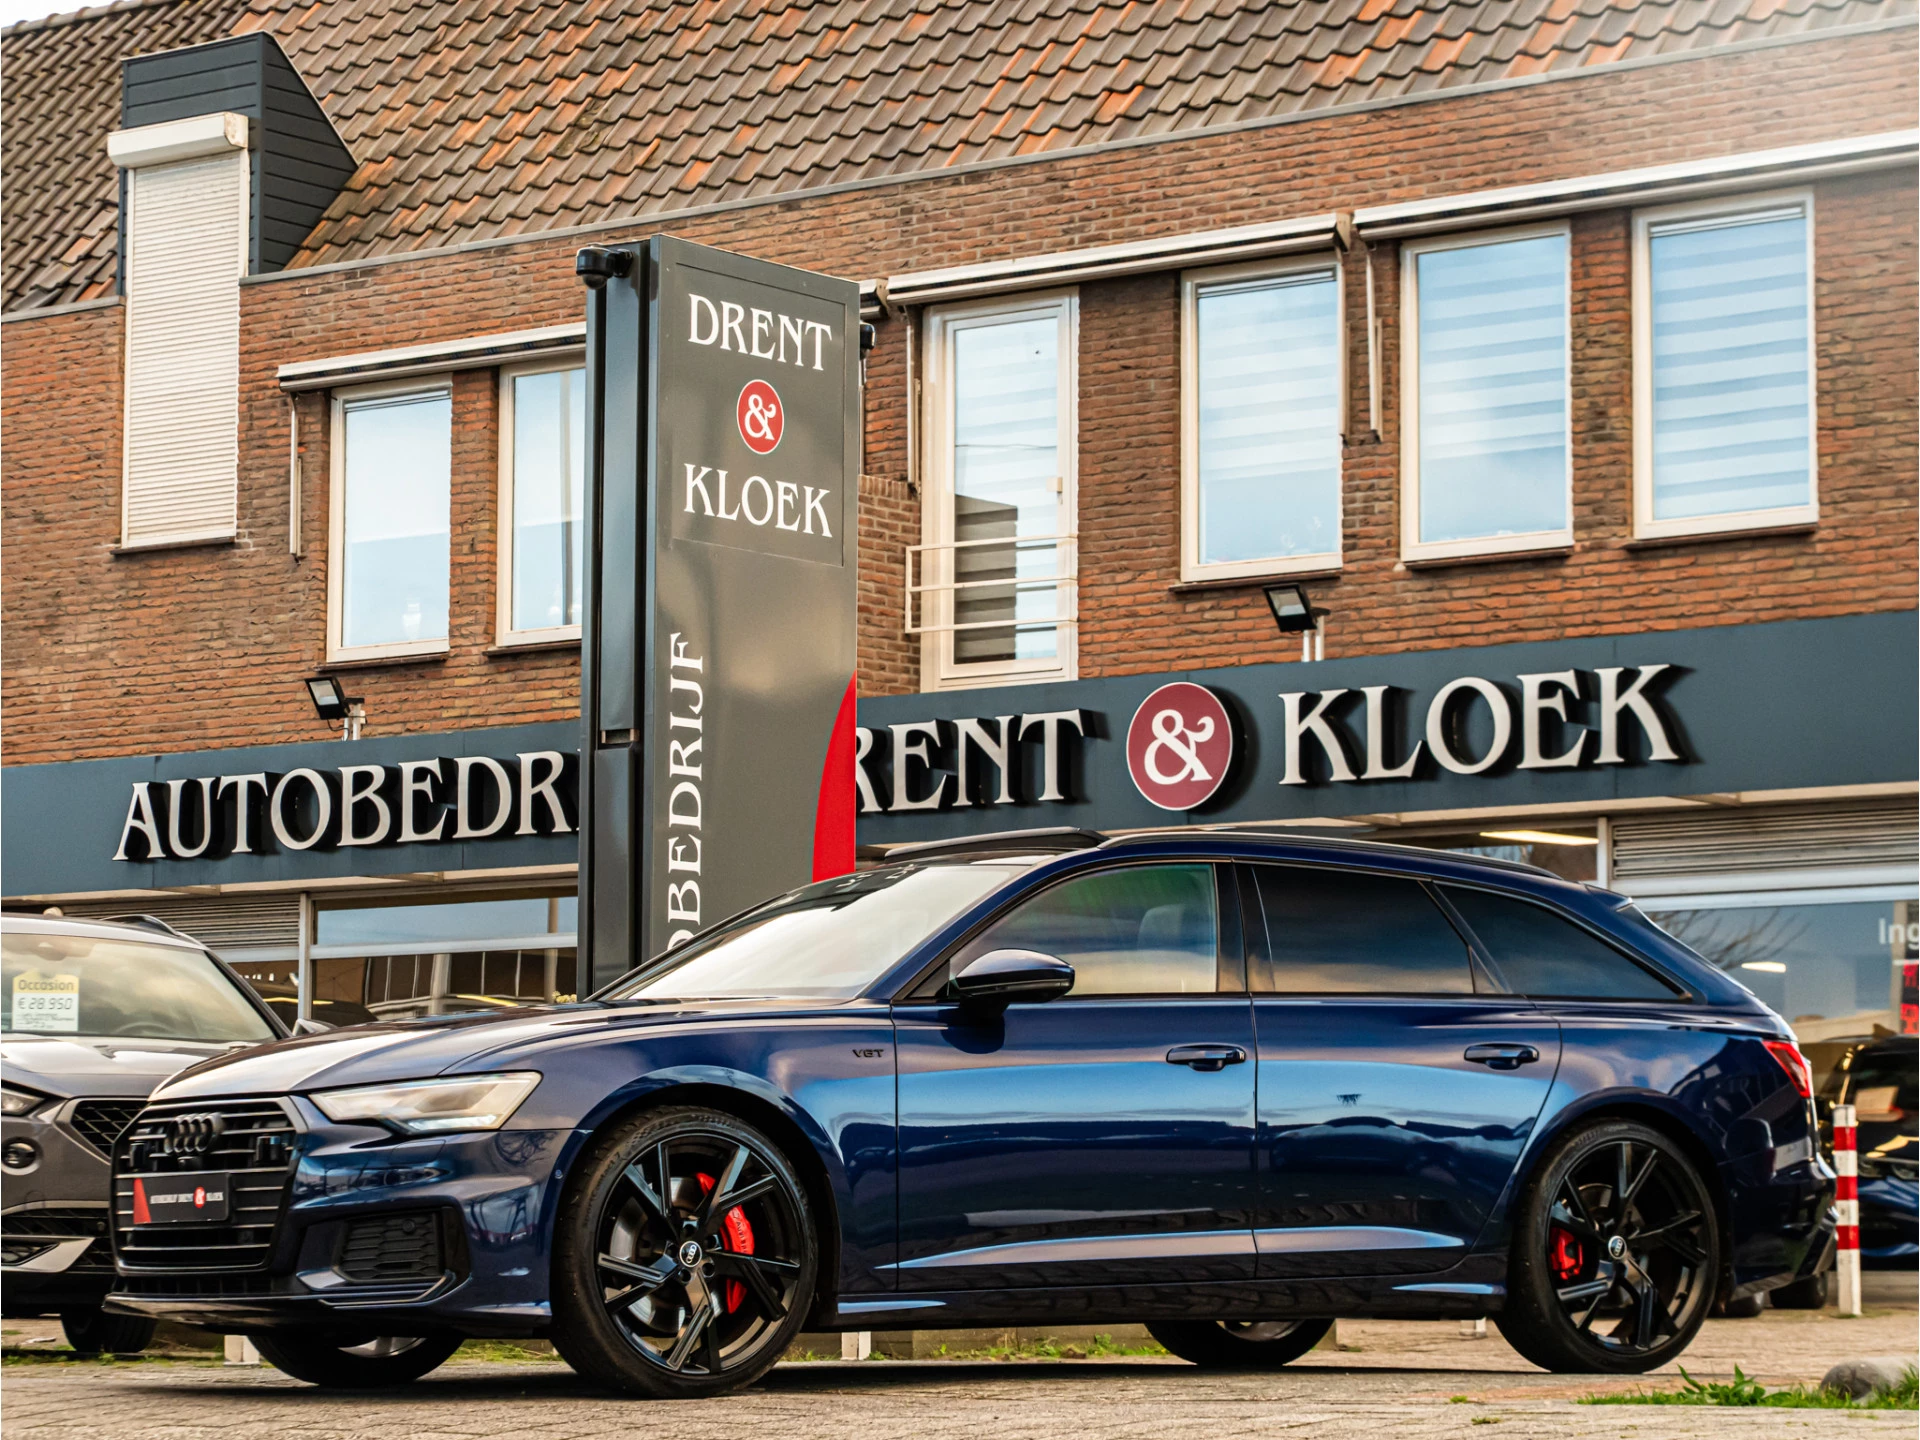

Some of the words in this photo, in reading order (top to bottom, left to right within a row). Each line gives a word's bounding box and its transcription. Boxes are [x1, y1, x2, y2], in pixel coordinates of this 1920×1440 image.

[688, 293, 832, 371] DRENT
[744, 394, 776, 441] &
[684, 463, 833, 538] KLOEK
[112, 748, 580, 861] AUTOBEDR
[1144, 709, 1214, 785] &
[1278, 664, 1680, 785] KLOEK
[18, 979, 74, 991] Occasion
